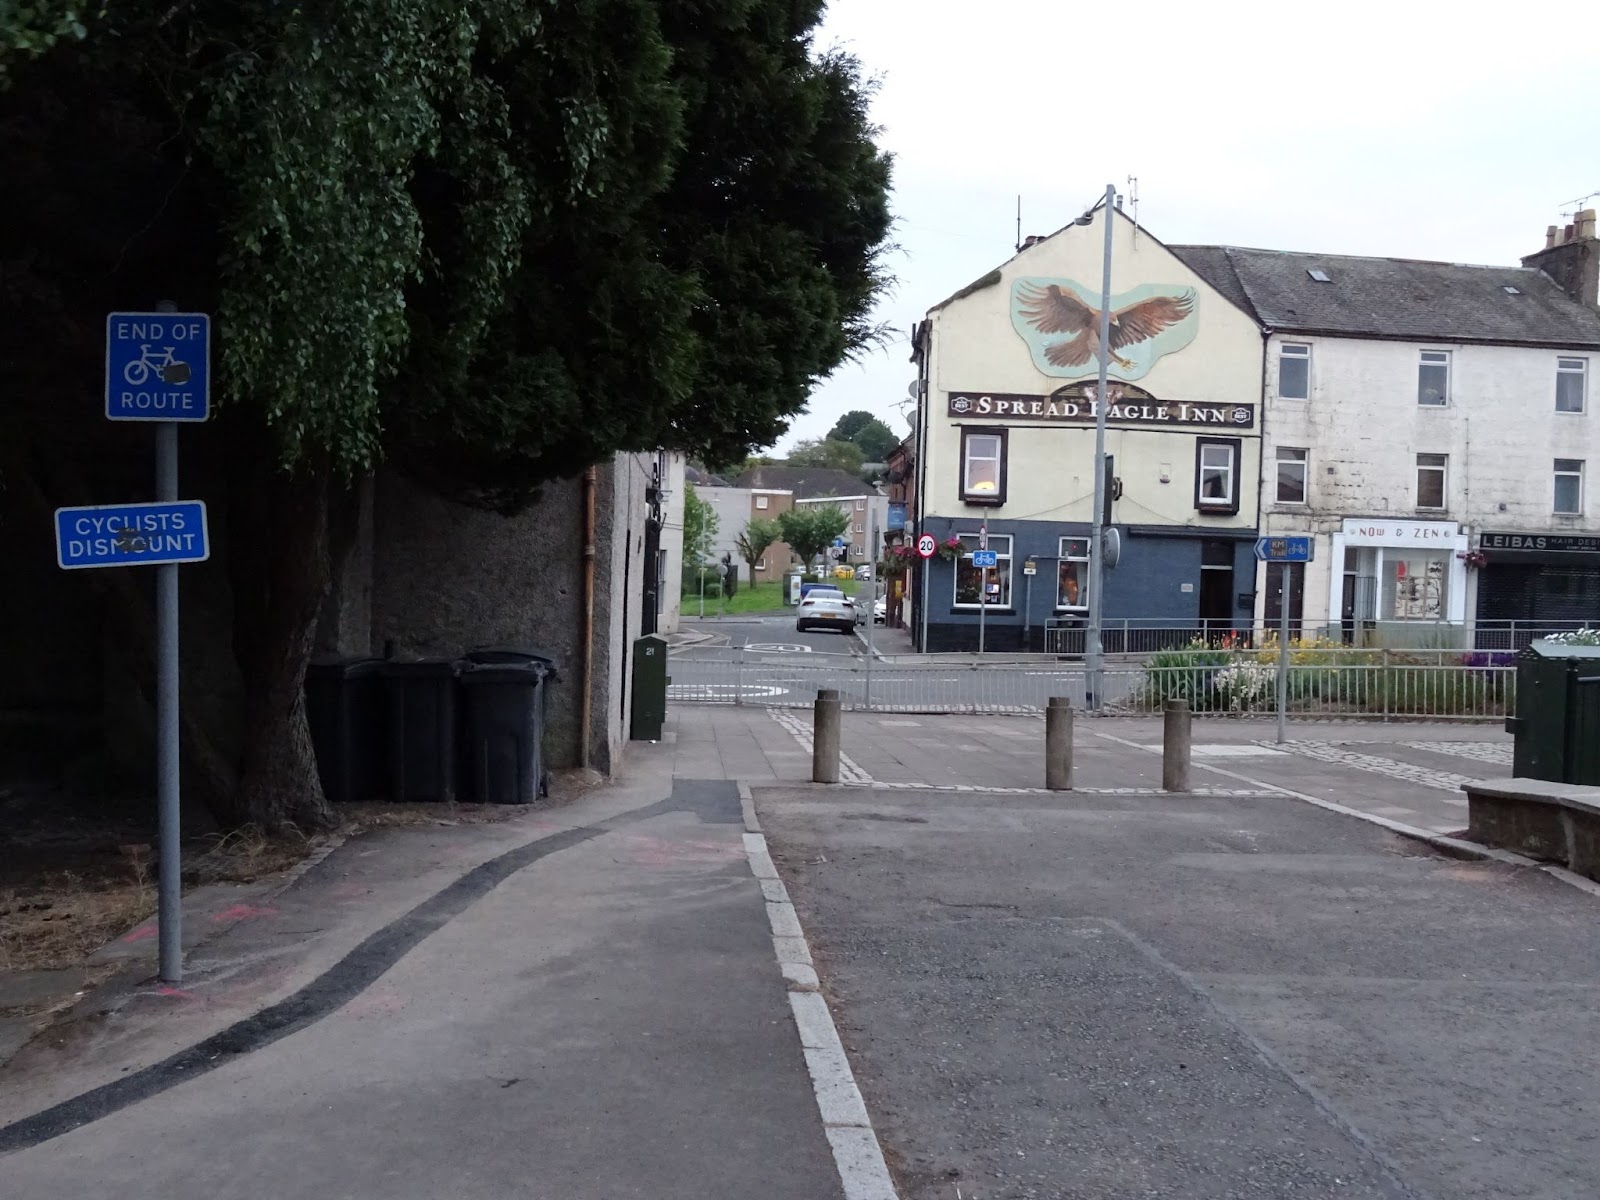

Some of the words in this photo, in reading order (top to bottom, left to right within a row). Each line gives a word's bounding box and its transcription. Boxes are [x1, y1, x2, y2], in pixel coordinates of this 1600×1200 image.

[118, 323, 163, 340] END
[172, 323, 200, 340] OF
[121, 392, 193, 409] ROUTE
[976, 396, 1079, 417] SPREAD
[1178, 404, 1227, 423] INN
[75, 512, 185, 535] CYCLISTS
[1359, 527, 1385, 537] NOW
[1396, 528, 1404, 537] &
[1414, 528, 1439, 538] ZEN
[920, 541, 933, 551] 20
[1483, 535, 1547, 549] LEIBAS
[645, 647, 655, 656] 21
